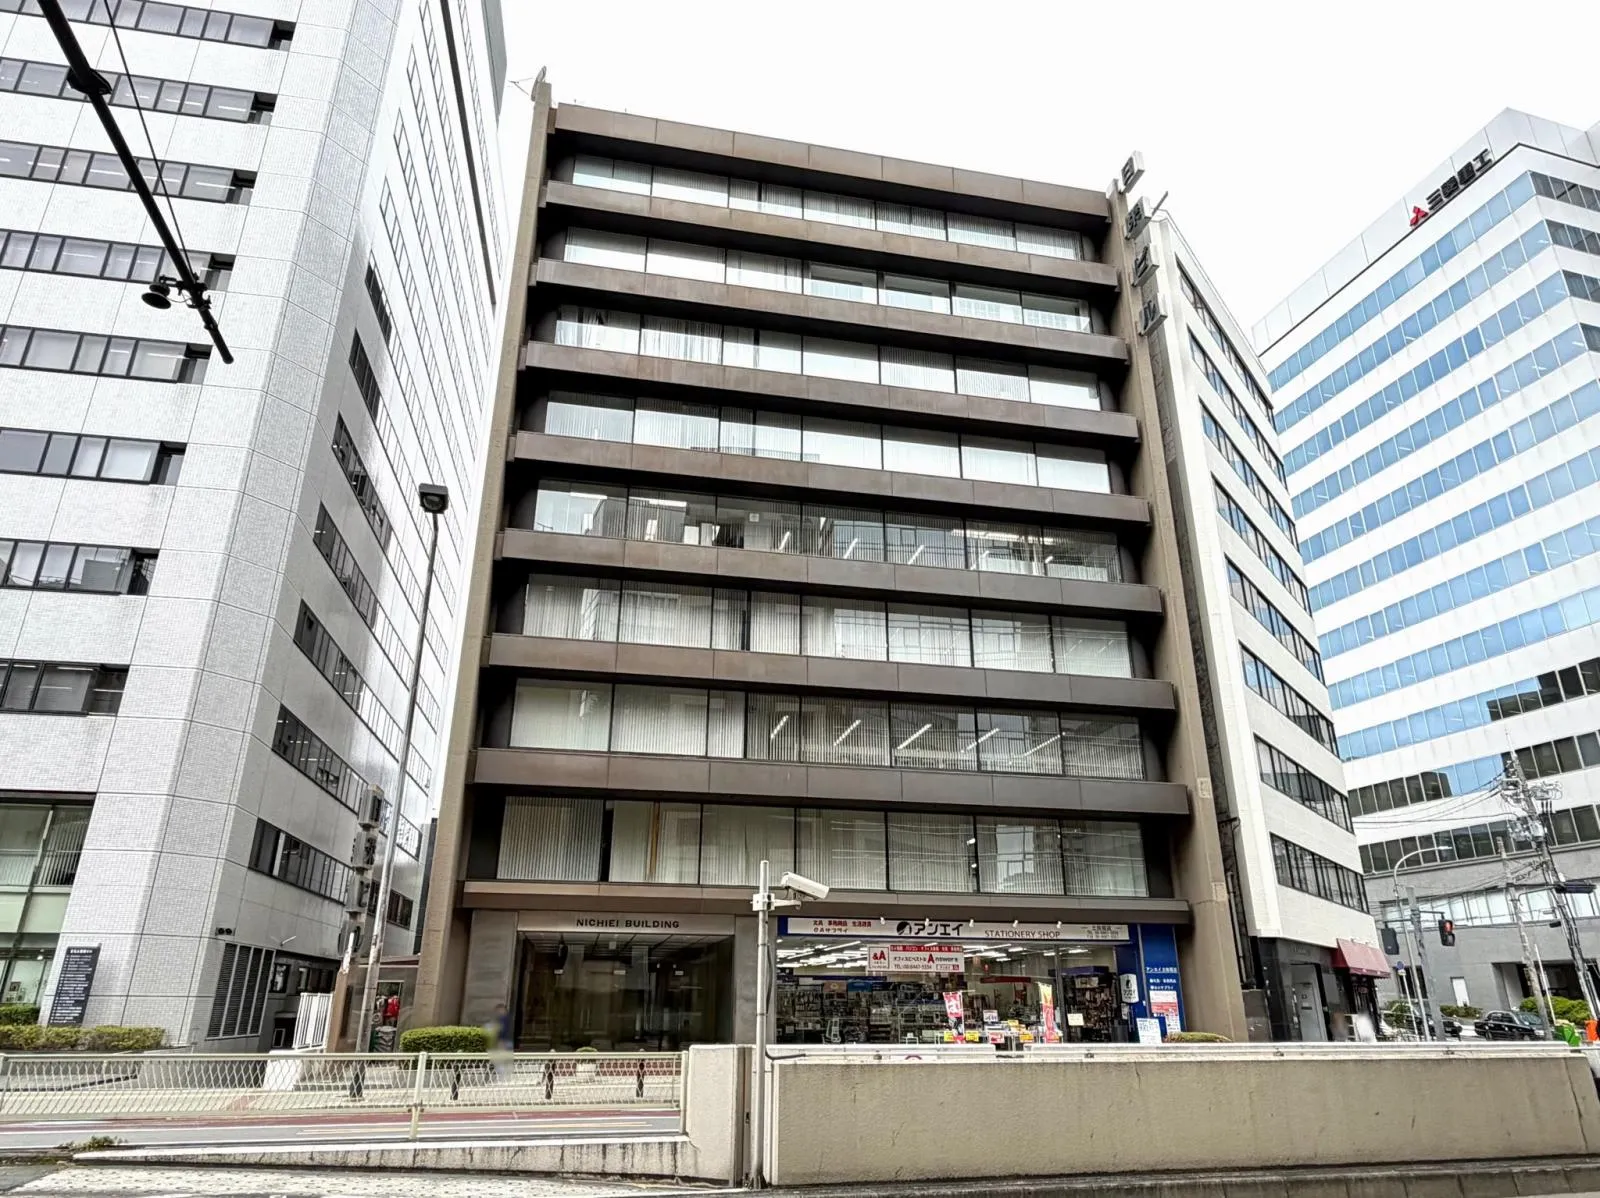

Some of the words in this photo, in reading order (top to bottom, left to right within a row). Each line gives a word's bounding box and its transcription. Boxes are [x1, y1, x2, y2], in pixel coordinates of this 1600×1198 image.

[576, 919, 619, 928] NICHIEI
[625, 919, 680, 929] BUILDING
[914, 922, 964, 936] アンエイ
[984, 929, 1035, 938] STATIONERY
[1038, 930, 1061, 939] SHOP
